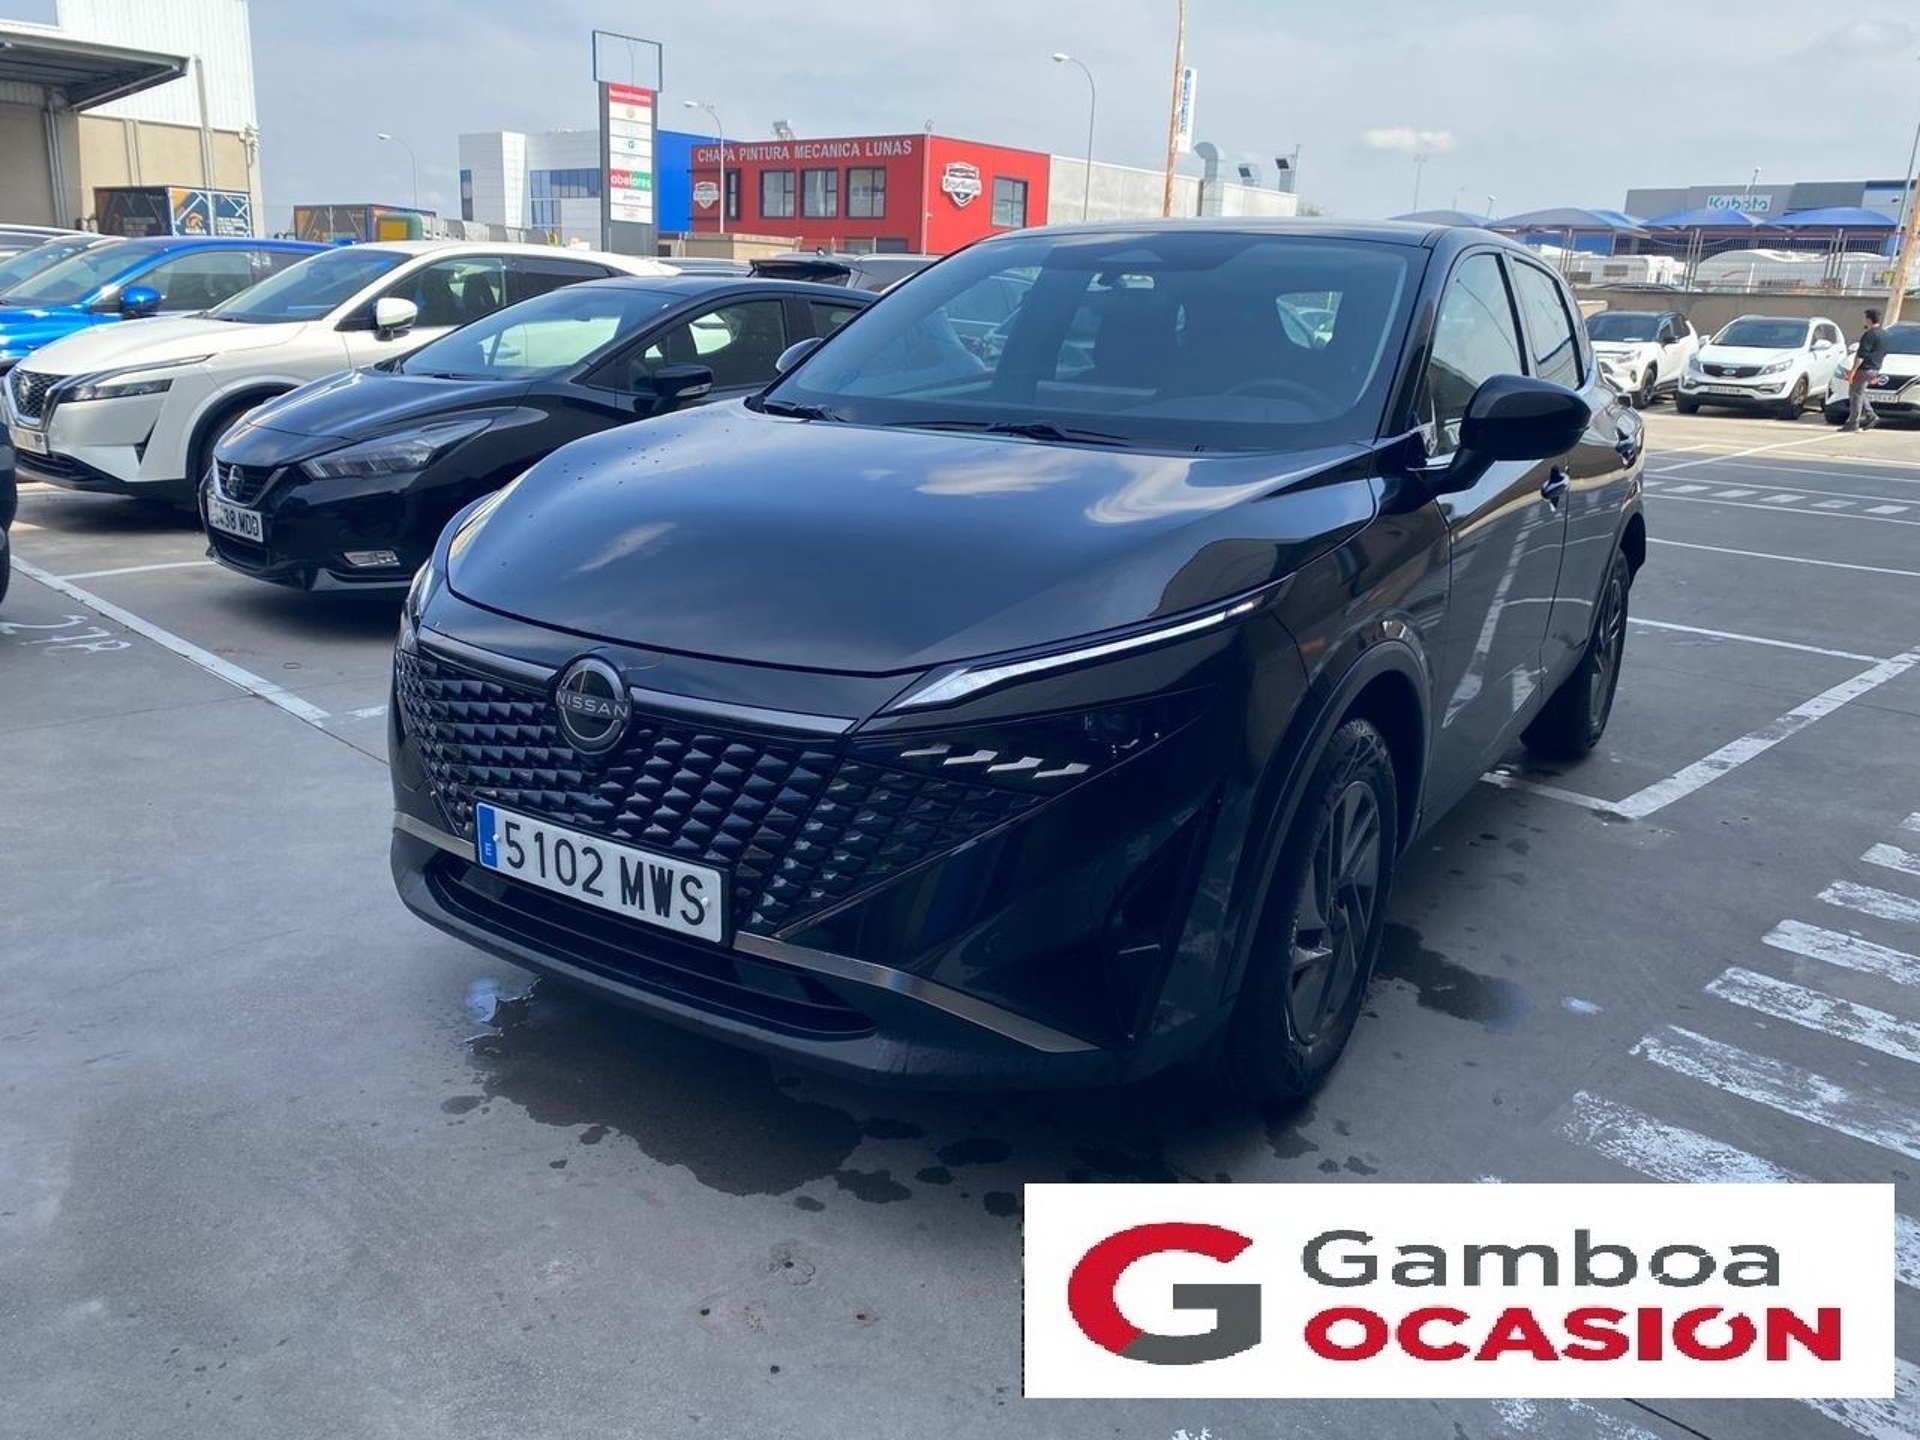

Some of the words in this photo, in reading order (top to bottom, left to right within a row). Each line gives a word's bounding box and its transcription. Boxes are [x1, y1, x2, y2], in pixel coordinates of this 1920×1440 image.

[697, 145, 736, 163] CHAPA
[739, 145, 790, 161] PINTURA
[794, 142, 860, 159] MECANICA
[865, 139, 913, 156] LUNAS
[213, 502, 237, 530] 38
[555, 690, 629, 718] NISSAN
[484, 842, 493, 857] E
[504, 820, 604, 898] 5102
[619, 855, 706, 926] MWS
